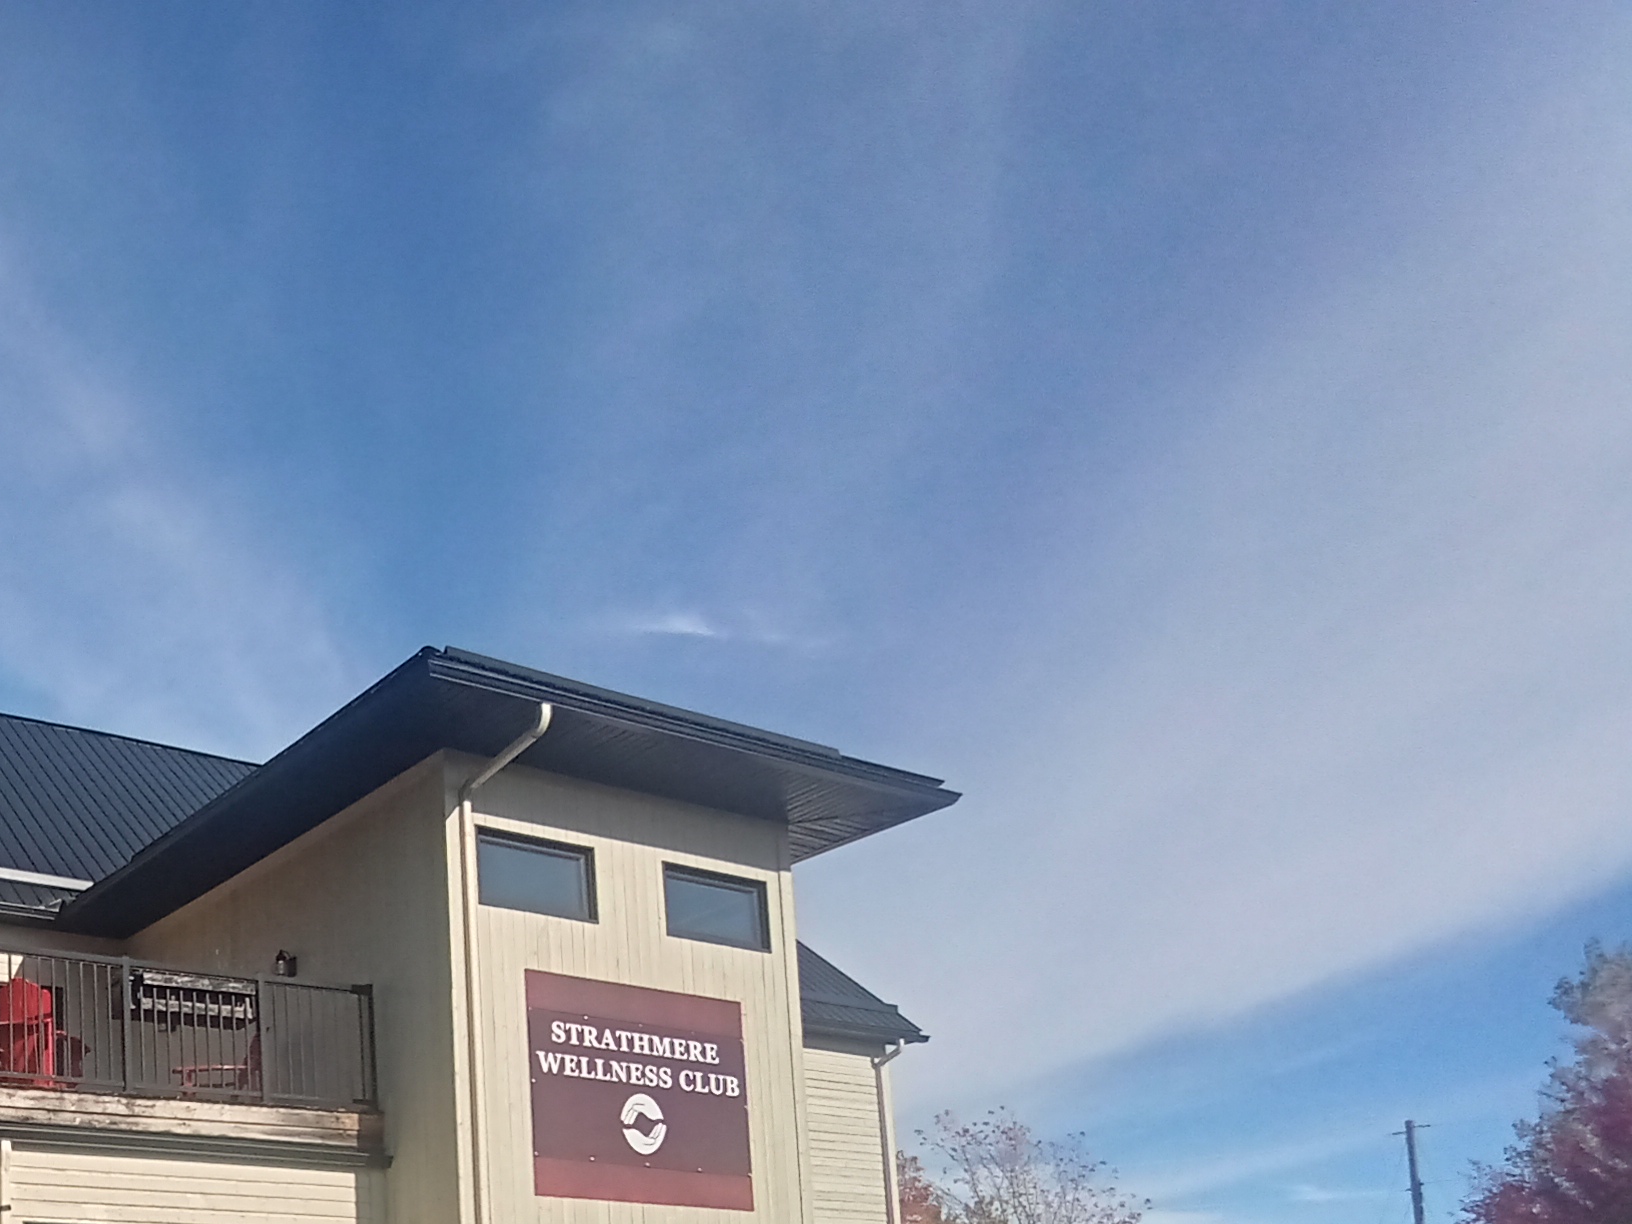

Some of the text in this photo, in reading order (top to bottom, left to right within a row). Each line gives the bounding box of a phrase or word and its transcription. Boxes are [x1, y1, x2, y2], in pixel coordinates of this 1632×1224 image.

[551, 1020, 719, 1065] STRATHMERE
[535, 1050, 740, 1097] WELLNESS CLUB
